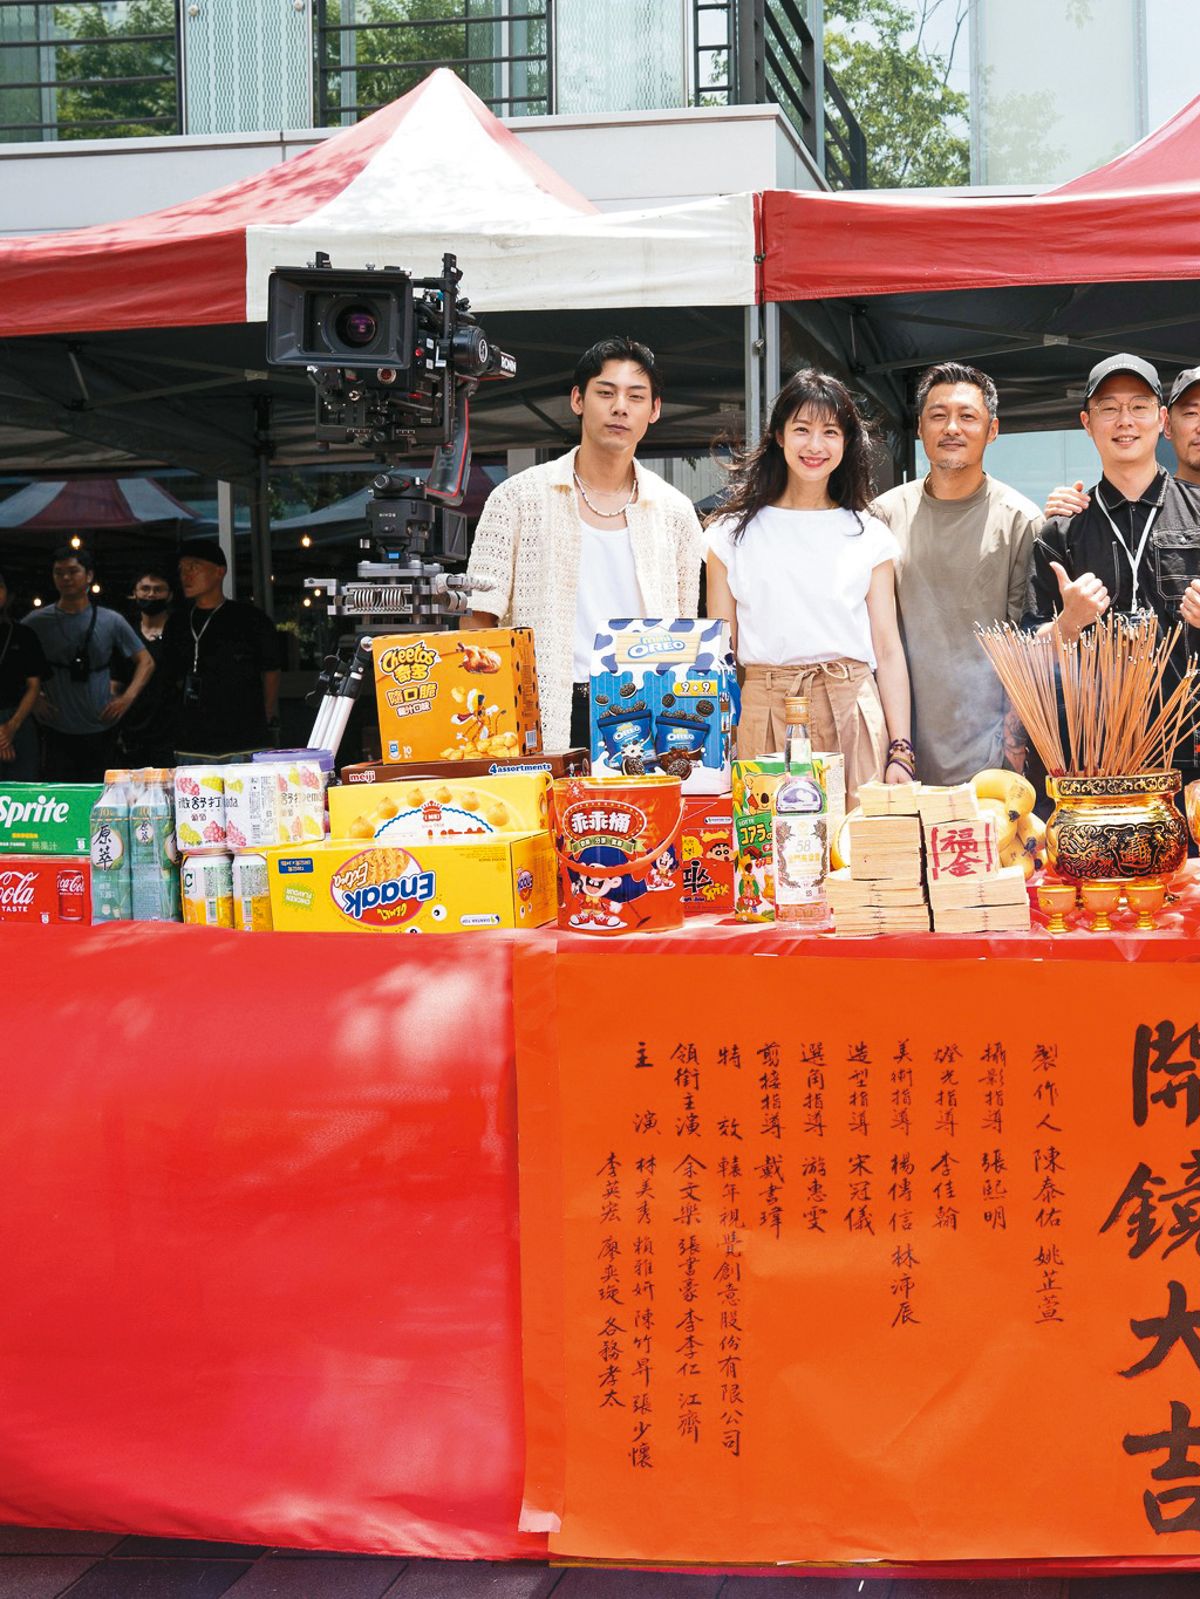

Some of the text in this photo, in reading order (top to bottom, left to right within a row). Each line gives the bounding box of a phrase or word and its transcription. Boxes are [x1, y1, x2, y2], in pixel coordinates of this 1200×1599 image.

[381, 642, 436, 672] Cheetos
[628, 640, 685, 658] OREO
[394, 664, 429, 682] 奇多
[349, 771, 375, 783] meiji
[0, 795, 69, 828] Sprite
[571, 811, 631, 833] 乖乖桶
[93, 824, 113, 871] 原萃
[343, 871, 435, 918] Enaak
